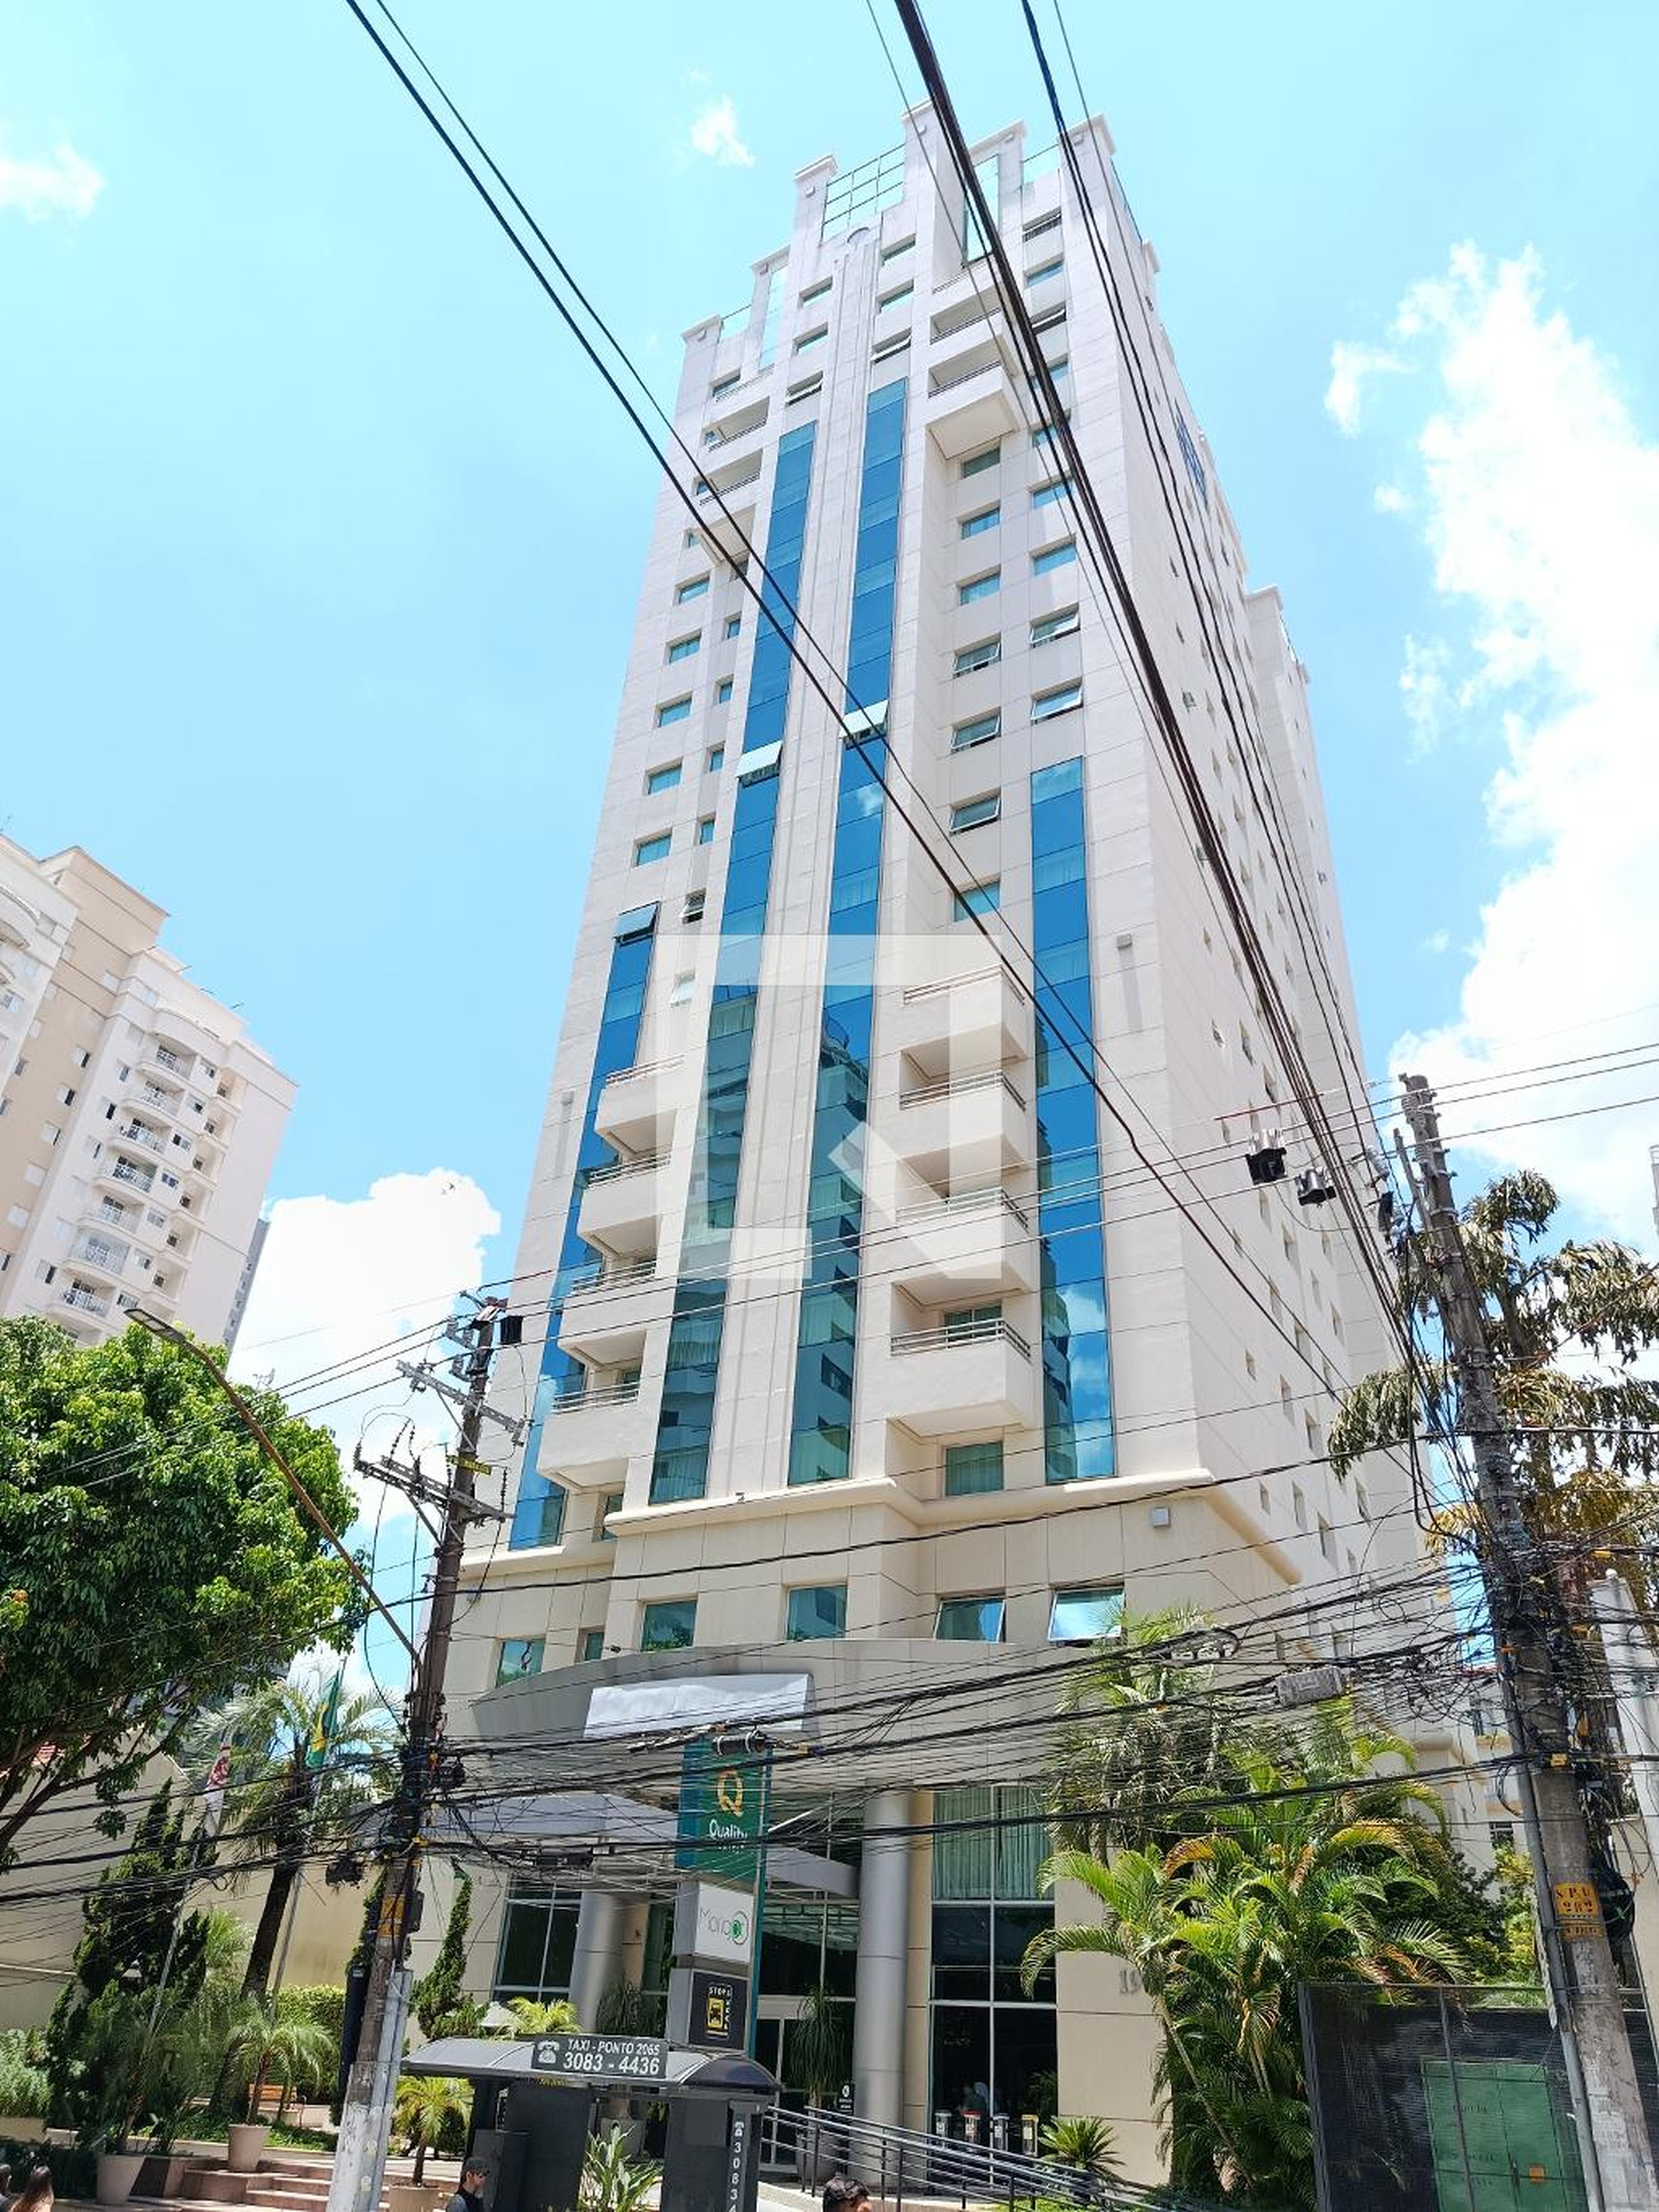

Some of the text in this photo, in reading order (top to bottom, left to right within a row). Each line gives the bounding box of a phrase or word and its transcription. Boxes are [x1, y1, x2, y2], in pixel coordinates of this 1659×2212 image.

[568, 2039, 591, 2050] TAXI
[597, 2041, 634, 2054] PONTO
[563, 2052, 603, 2071] 3083
[618, 2056, 660, 2074] 4436
